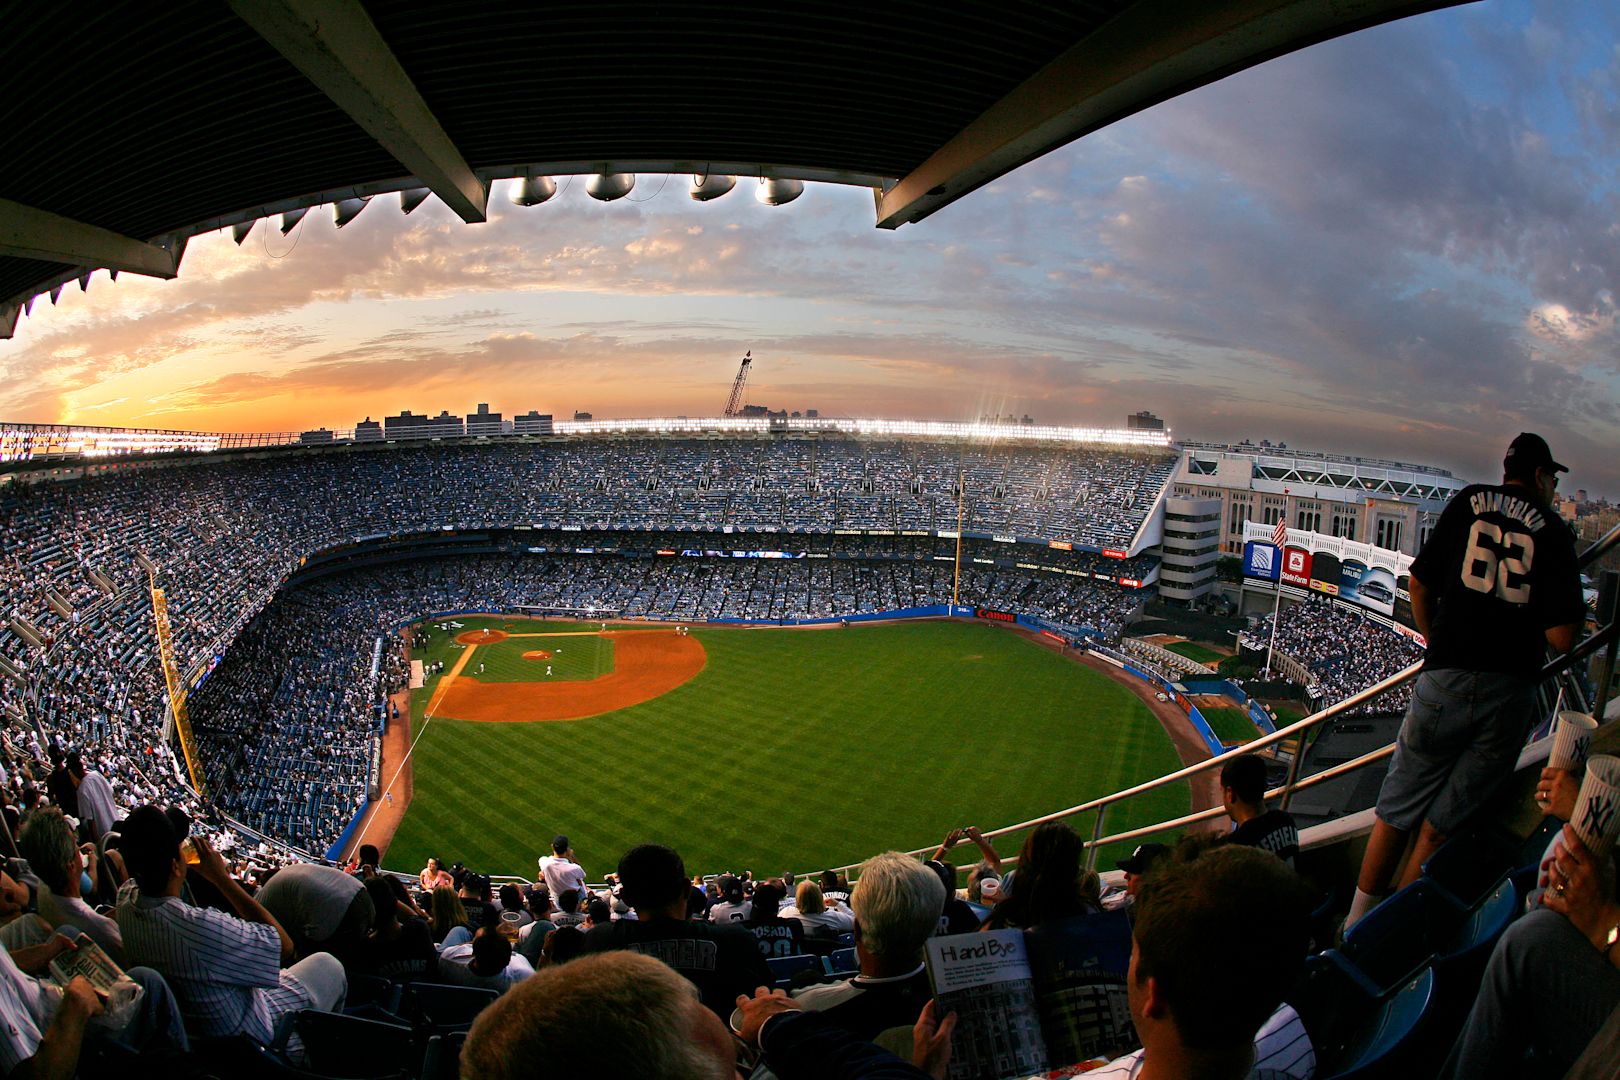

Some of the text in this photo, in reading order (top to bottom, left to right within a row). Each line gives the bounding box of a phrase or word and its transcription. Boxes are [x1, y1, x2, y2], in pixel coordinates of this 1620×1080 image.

[1342, 568, 1361, 579] MALIBU
[1461, 520, 1535, 604] 62
[977, 609, 1014, 622] Canon
[628, 938, 717, 971] ETER
[940, 939, 1016, 962] Hi and Bye
